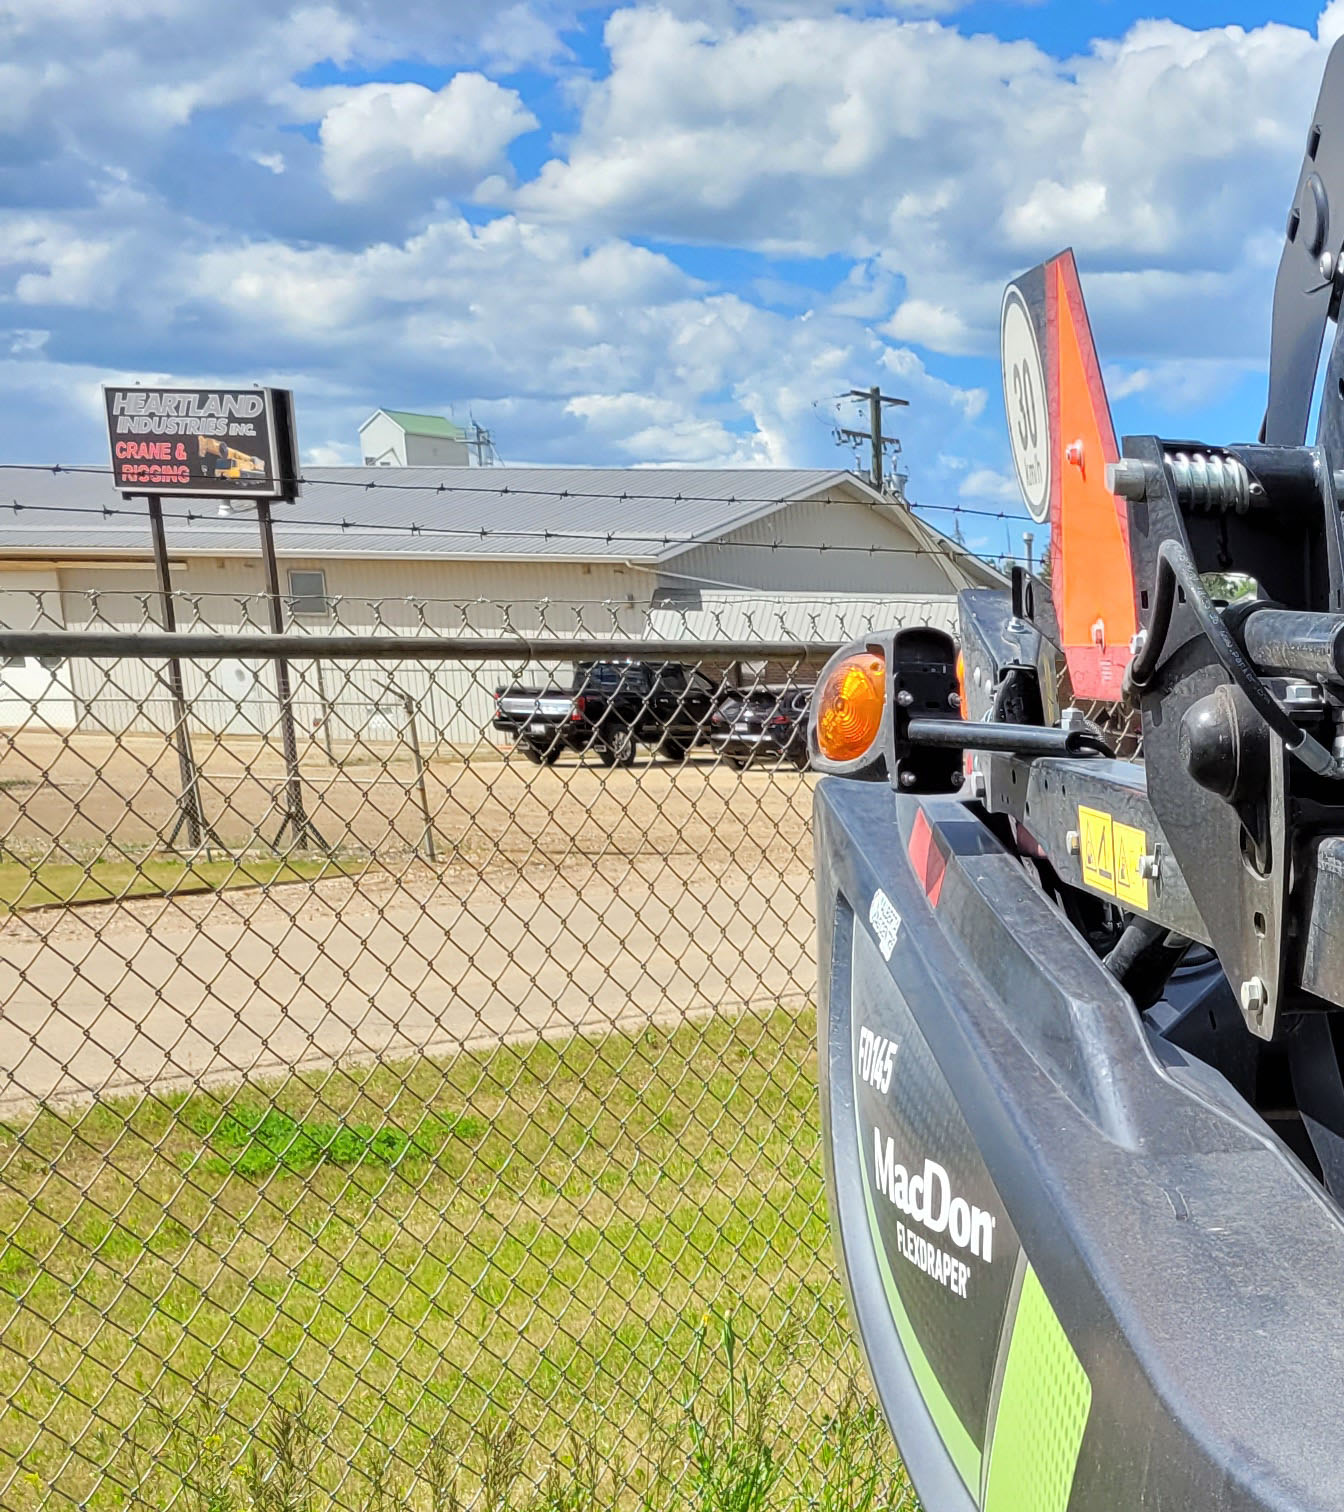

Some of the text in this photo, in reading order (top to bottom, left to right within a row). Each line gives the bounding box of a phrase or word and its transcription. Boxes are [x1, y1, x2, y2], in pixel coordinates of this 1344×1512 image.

[112, 392, 264, 418] HEARTLAND
[116, 416, 228, 436] INDUSTRIES
[1013, 357, 1038, 451] 30
[115, 441, 188, 461] CRANE &
[121, 464, 190, 484] RIGGING
[857, 1025, 899, 1095] FD145
[874, 1126, 993, 1264] MacDon
[896, 1220, 969, 1299] FLEXDRAPER
